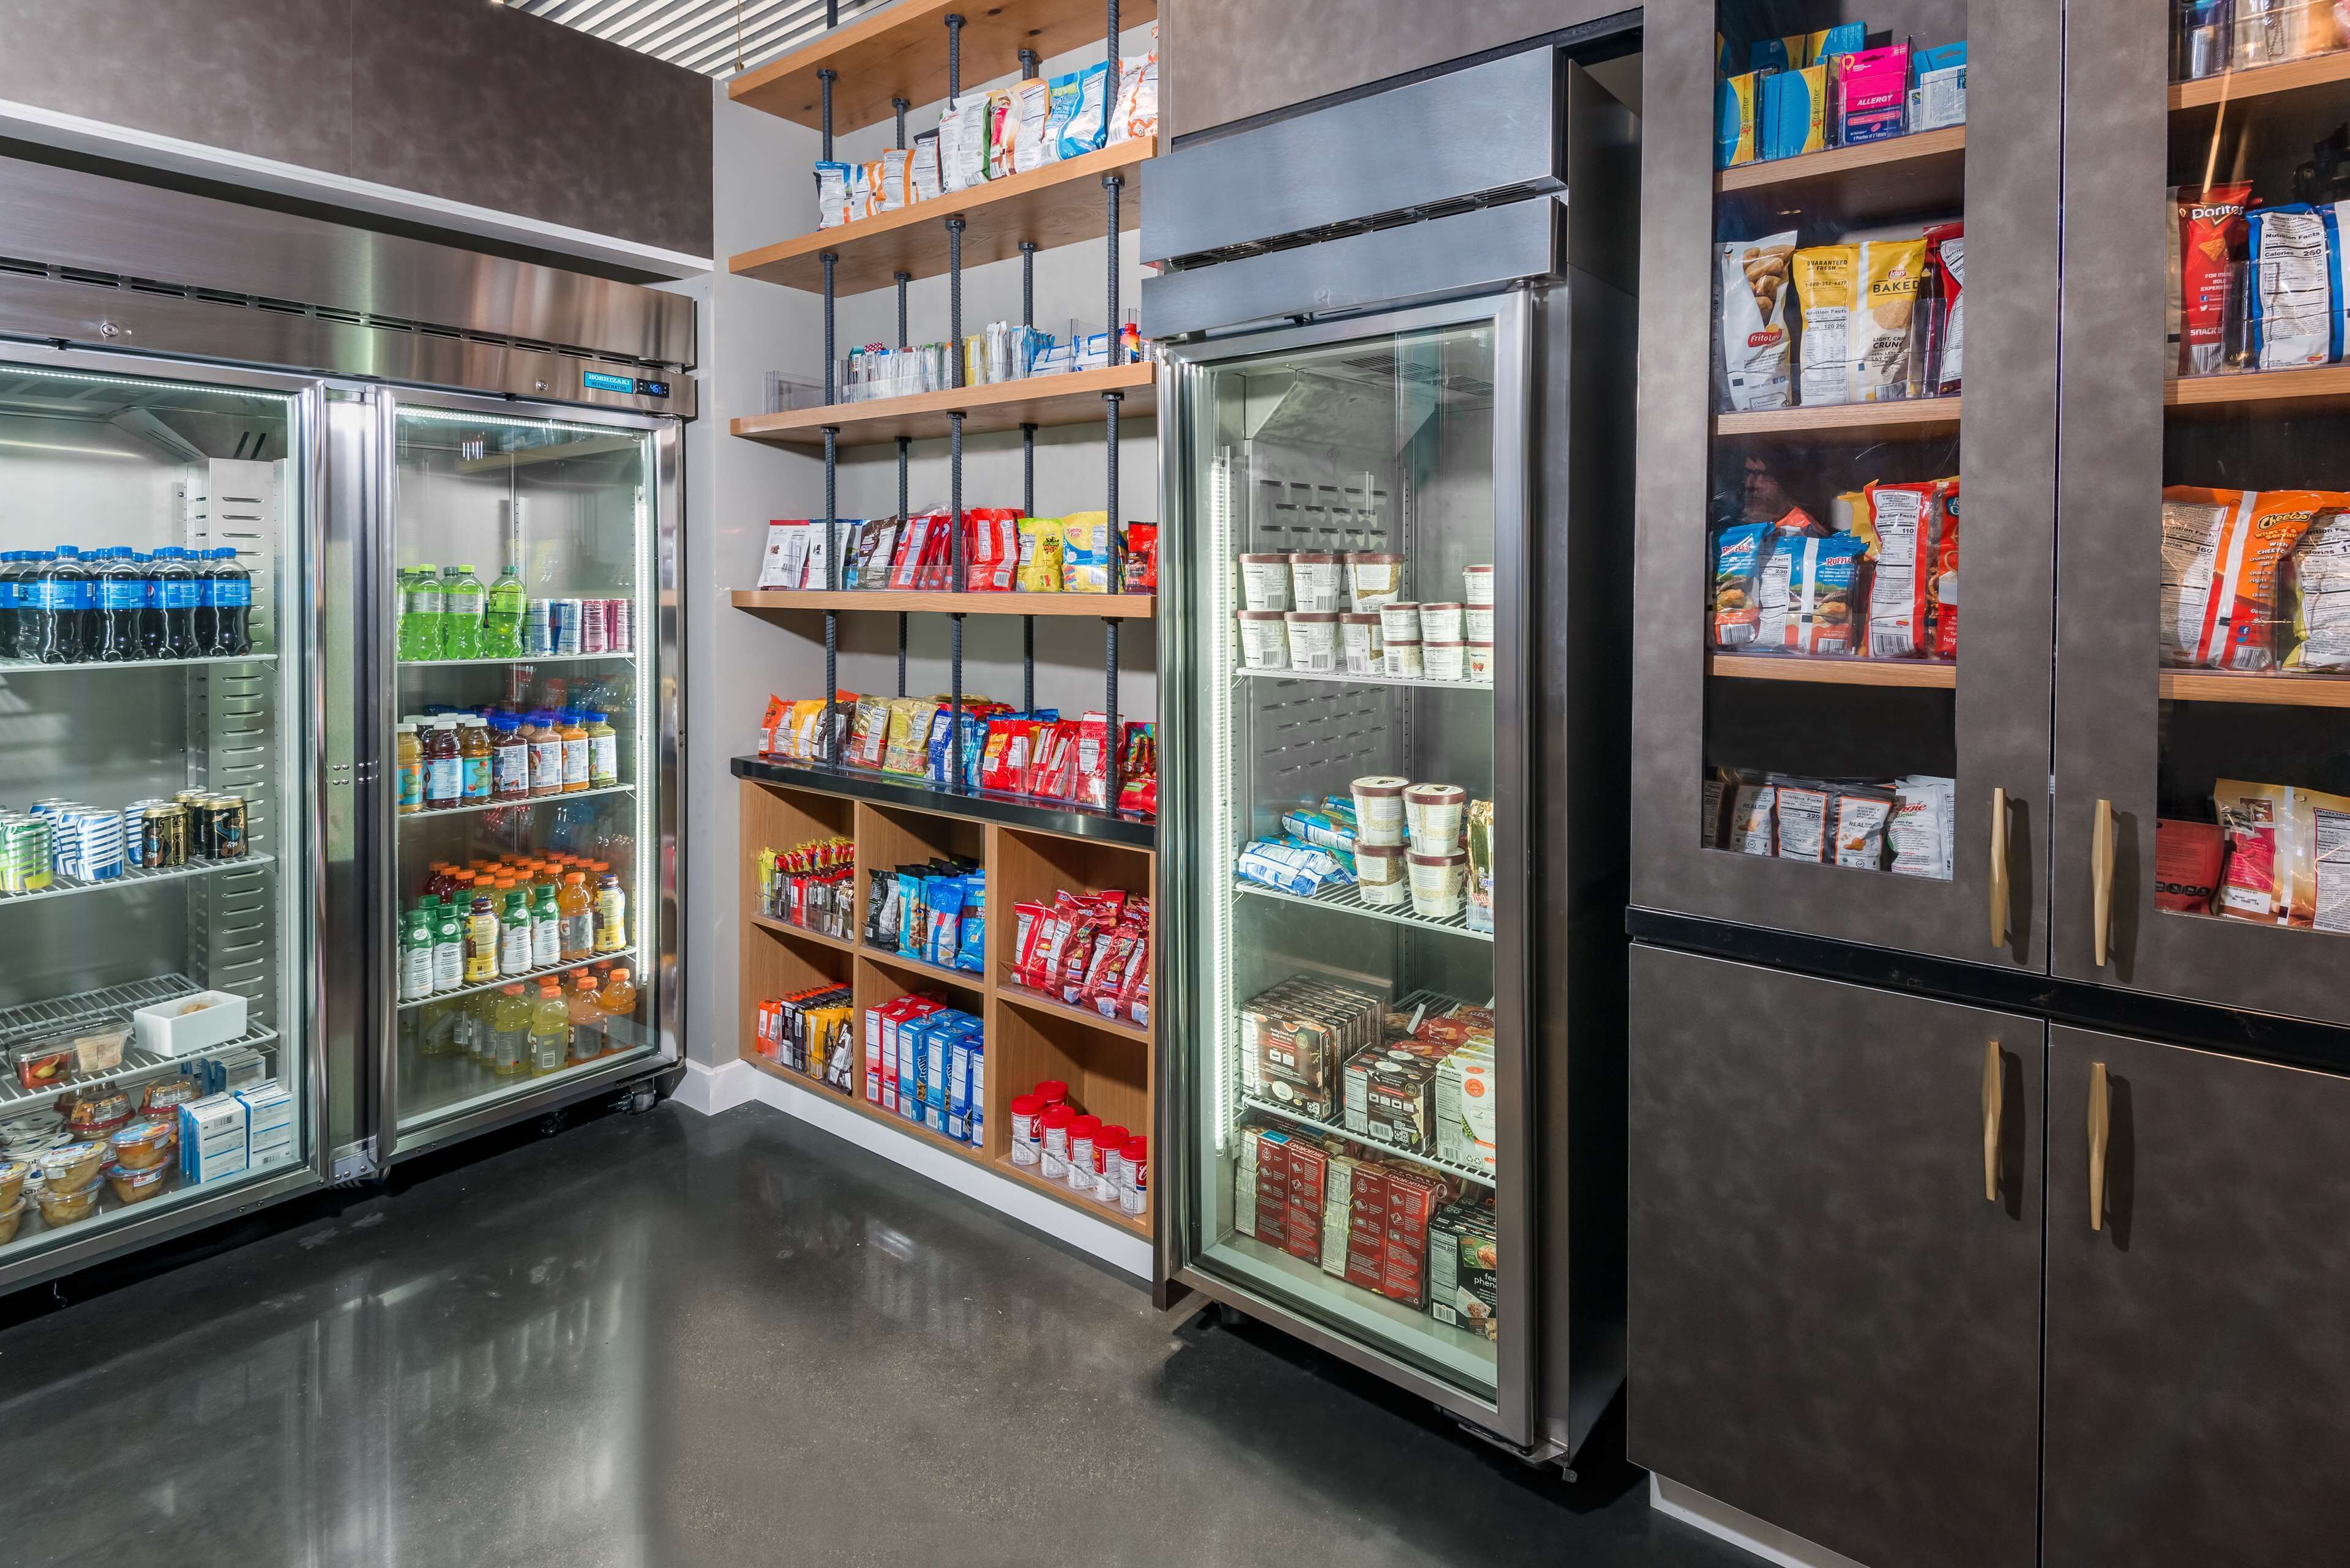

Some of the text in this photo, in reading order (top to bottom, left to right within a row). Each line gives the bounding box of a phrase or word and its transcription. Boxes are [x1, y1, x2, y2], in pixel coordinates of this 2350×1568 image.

[1857, 94, 1893, 106] ALLERGY
[2191, 205, 2245, 220] Doritos
[1873, 280, 1920, 293] BAKED
[2190, 327, 2217, 336] SNACK
[588, 374, 630, 386] HOSHIZAKI
[591, 381, 627, 391] REFRIGERATOR
[2259, 512, 2311, 529] Cheetos
[1826, 556, 1851, 566] RUFFLE
[1289, 1142, 1325, 1159] DIGIORNO
[1388, 1174, 1429, 1190] DIGIORNO
[1474, 1277, 1496, 1288] phen
[1484, 1273, 1496, 1282] fee
